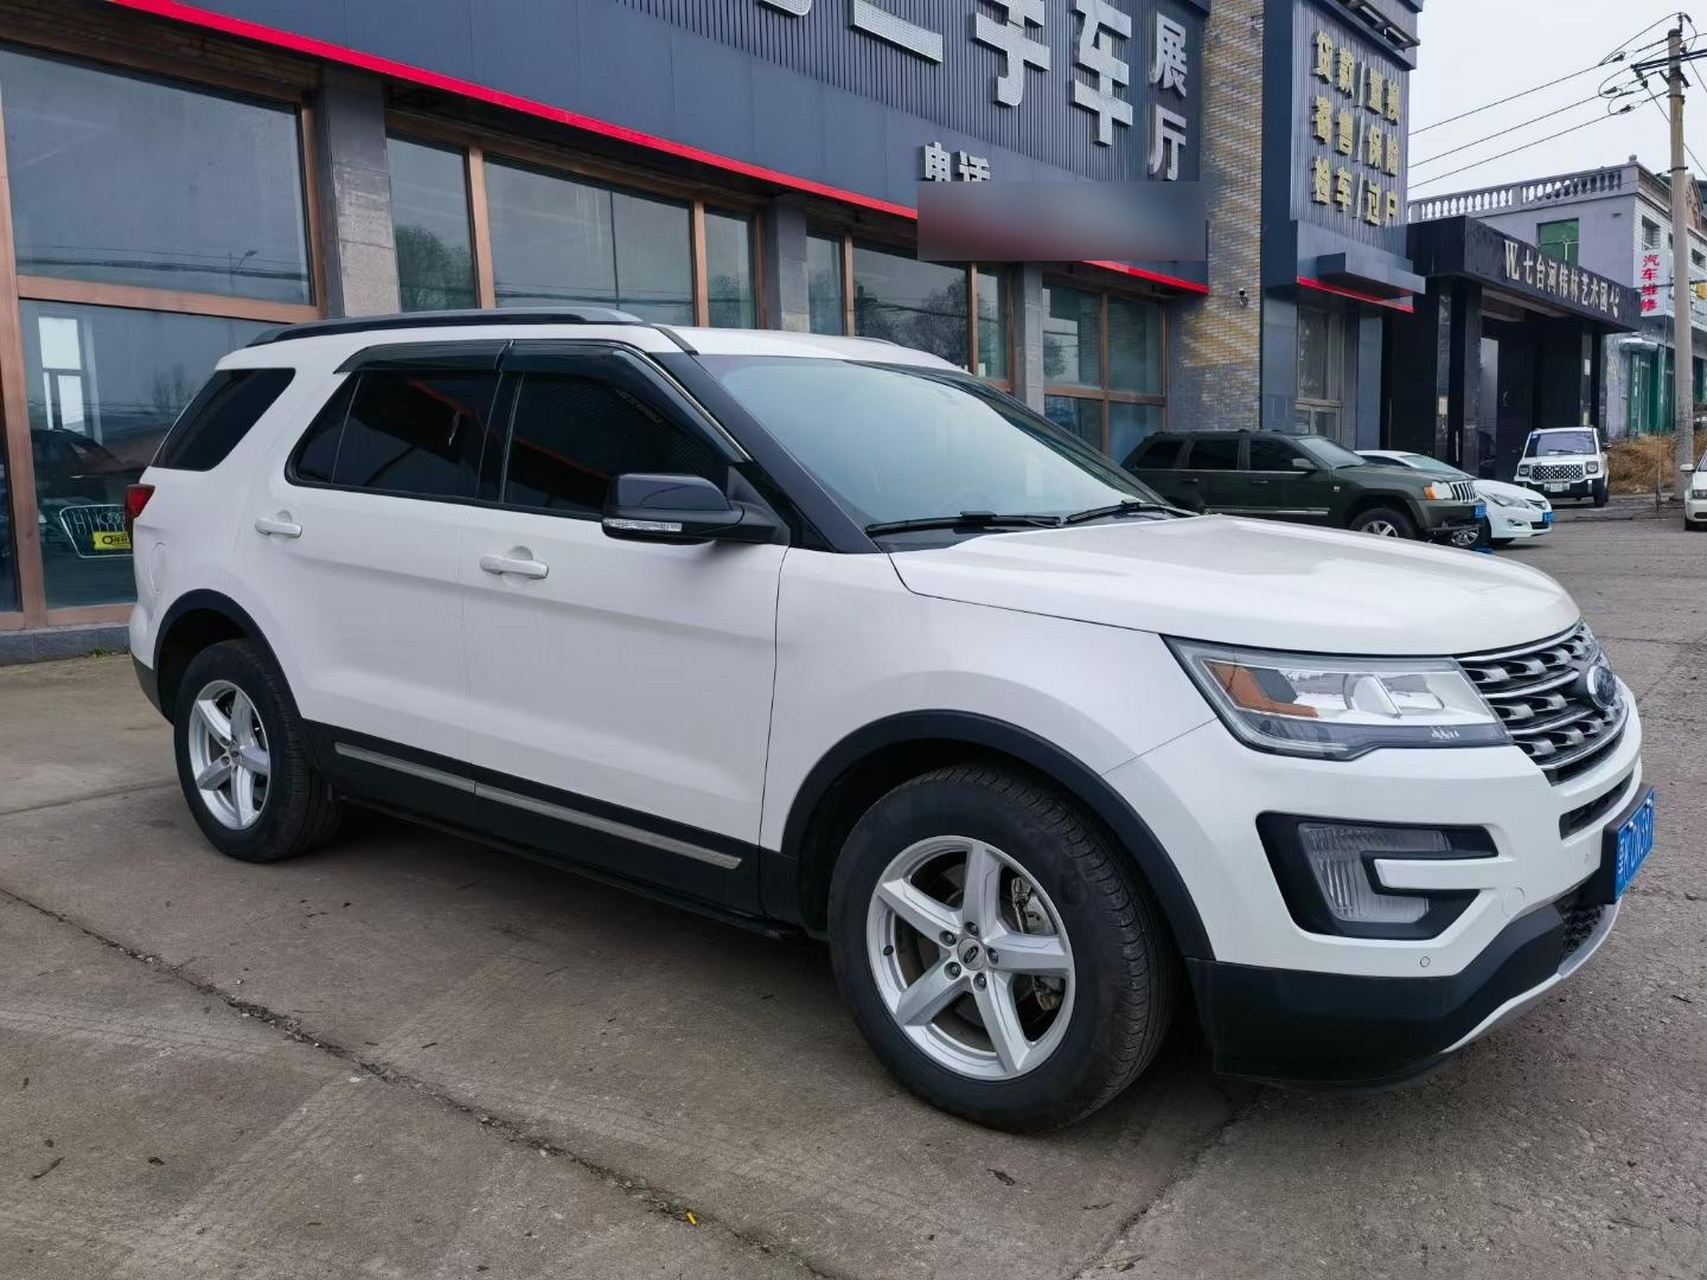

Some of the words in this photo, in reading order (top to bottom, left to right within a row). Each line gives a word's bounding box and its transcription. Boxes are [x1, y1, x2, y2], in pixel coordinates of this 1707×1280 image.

[1149, 12, 1188, 181] 展厅
[1640, 254, 1660, 312] 汽车维修
